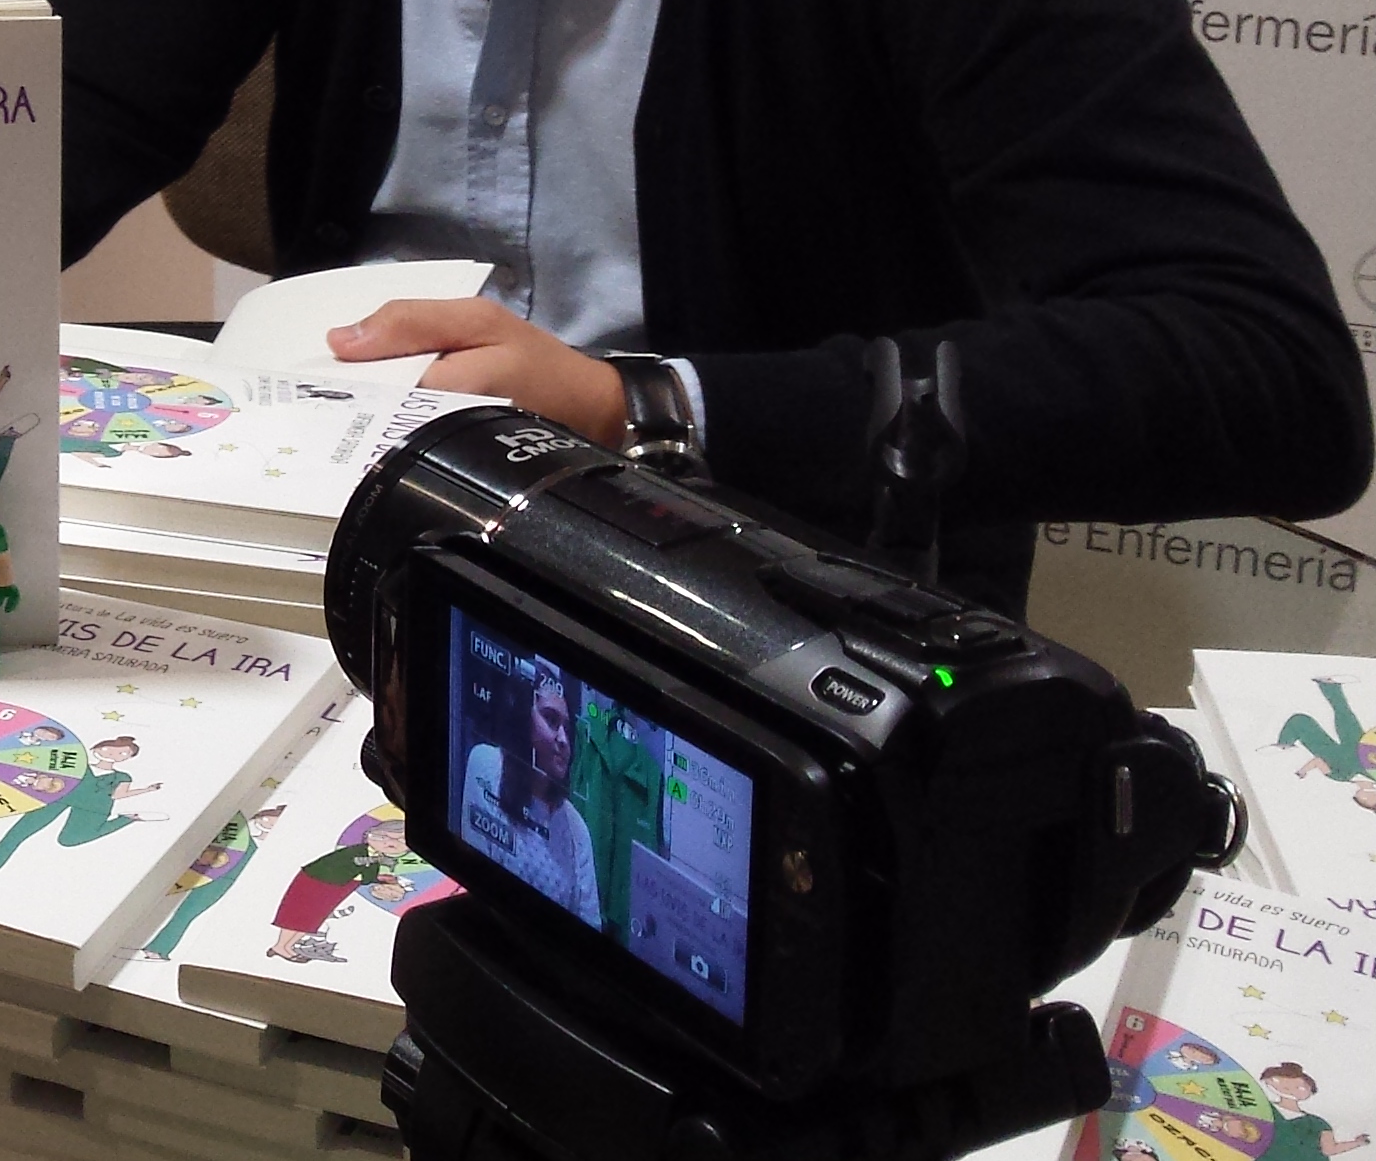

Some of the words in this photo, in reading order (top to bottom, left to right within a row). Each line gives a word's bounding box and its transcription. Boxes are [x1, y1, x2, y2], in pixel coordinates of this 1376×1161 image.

[140, 616, 172, 630] vida
[198, 627, 249, 645] suero
[91, 652, 169, 675] SATURADA
[111, 630, 166, 654] DE
[171, 642, 218, 667] LA
[231, 654, 293, 683] IRA
[474, 637, 507, 669] FUNC.
[826, 681, 870, 709] POWER
[474, 812, 509, 844] ZOOM
[1214, 889, 1253, 909] vida
[1260, 904, 1285, 917] es
[1290, 913, 1350, 936] suero
[1198, 907, 1256, 941] DE
[1275, 928, 1333, 965] LA
[1186, 937, 1284, 973] SATURADA
